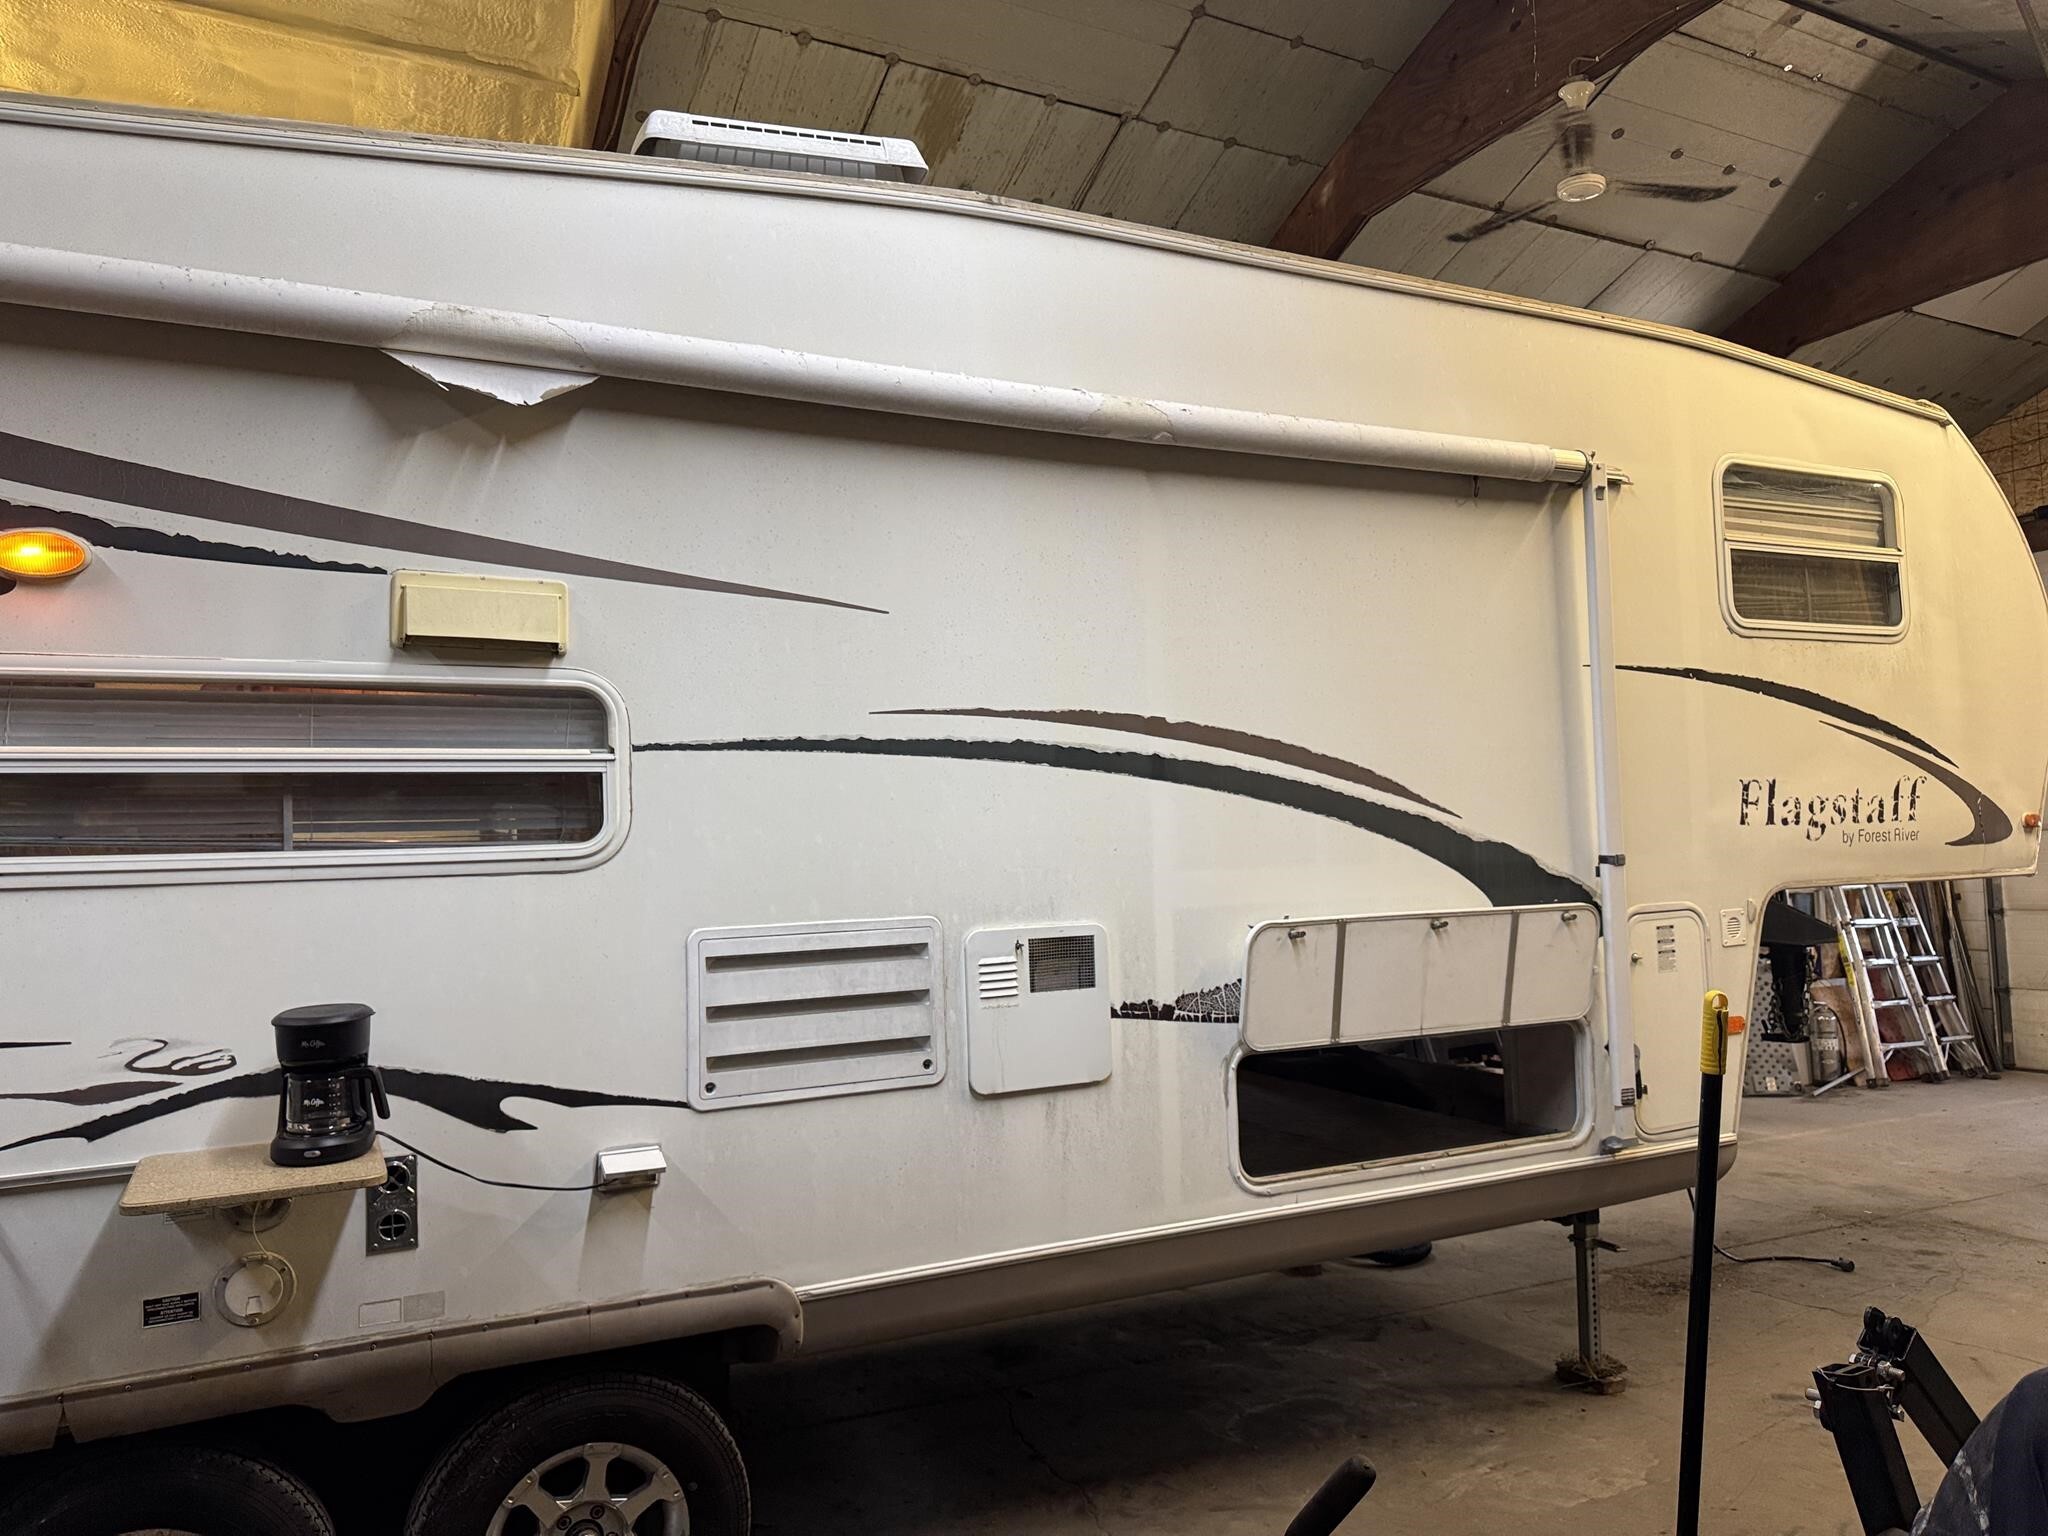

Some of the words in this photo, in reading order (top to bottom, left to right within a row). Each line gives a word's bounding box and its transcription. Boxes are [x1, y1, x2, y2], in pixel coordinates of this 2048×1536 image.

[1739, 774, 1928, 841] Flagstaff
[1842, 830, 1855, 848] by
[1858, 828, 1891, 843] Forest
[1894, 827, 1920, 842] River
